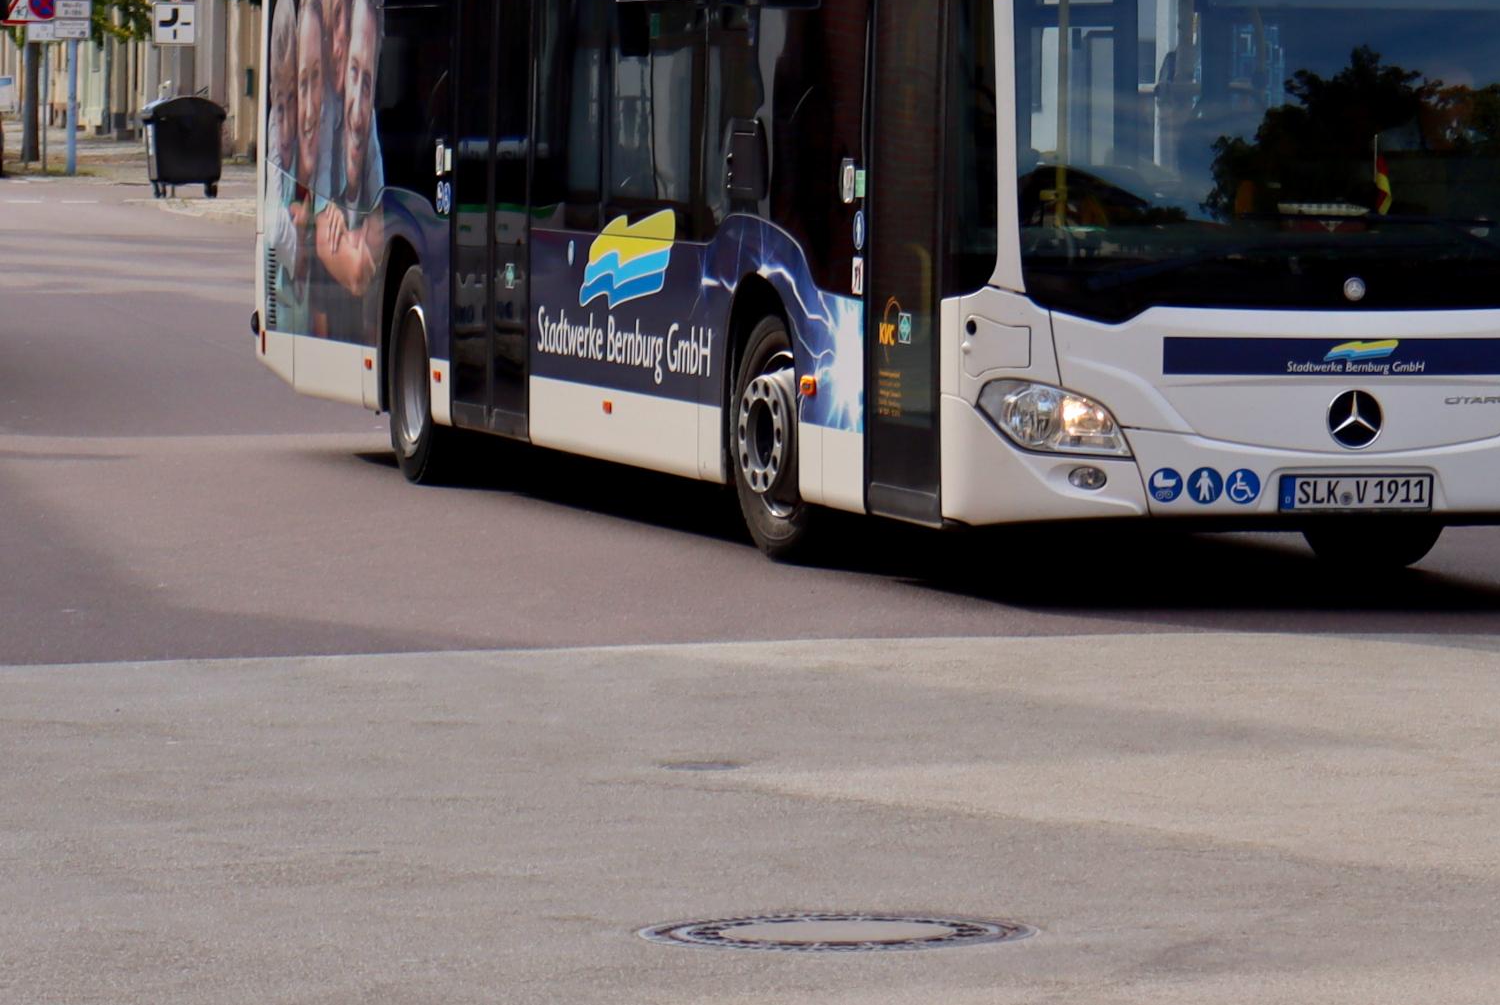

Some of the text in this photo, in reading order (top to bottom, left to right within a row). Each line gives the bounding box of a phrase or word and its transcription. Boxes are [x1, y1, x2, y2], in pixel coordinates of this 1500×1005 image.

[537, 305, 712, 385] Stadtwerke Bernburg GmbH
[1287, 360, 1425, 375] Stadtwerke Bernburg GmbH
[1298, 479, 1425, 504] SLK V 1911
